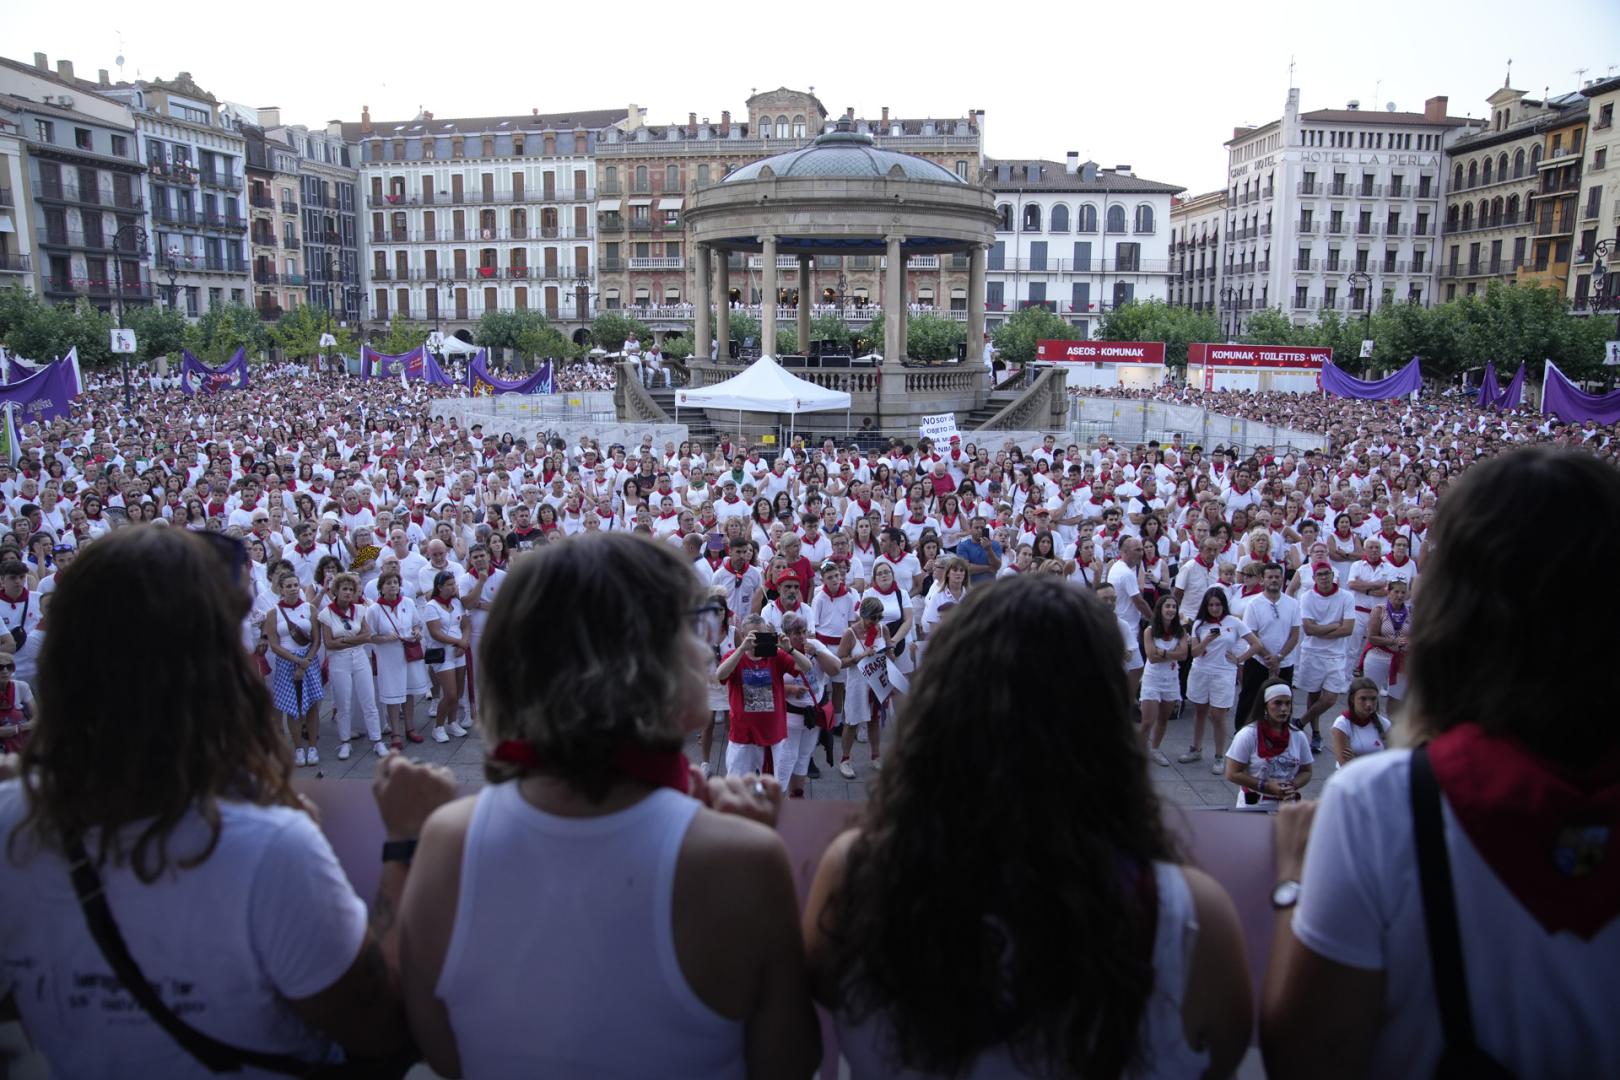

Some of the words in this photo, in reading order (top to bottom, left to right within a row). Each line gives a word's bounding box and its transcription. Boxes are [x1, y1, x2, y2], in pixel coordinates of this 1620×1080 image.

[1254, 155, 1277, 171] HOTEL
[1300, 151, 1350, 164] HOTEL
[1358, 153, 1380, 165] LA
[1388, 153, 1439, 166] PERLA
[1066, 346, 1096, 356] ASEOS
[1100, 347, 1144, 357] KOMUNAK
[1212, 350, 1254, 360] KOMUNAK
[1259, 351, 1306, 362] TOILETTES
[923, 416, 935, 425] NO
[936, 416, 947, 424] SOY
[926, 426, 948, 434] OBJETO
